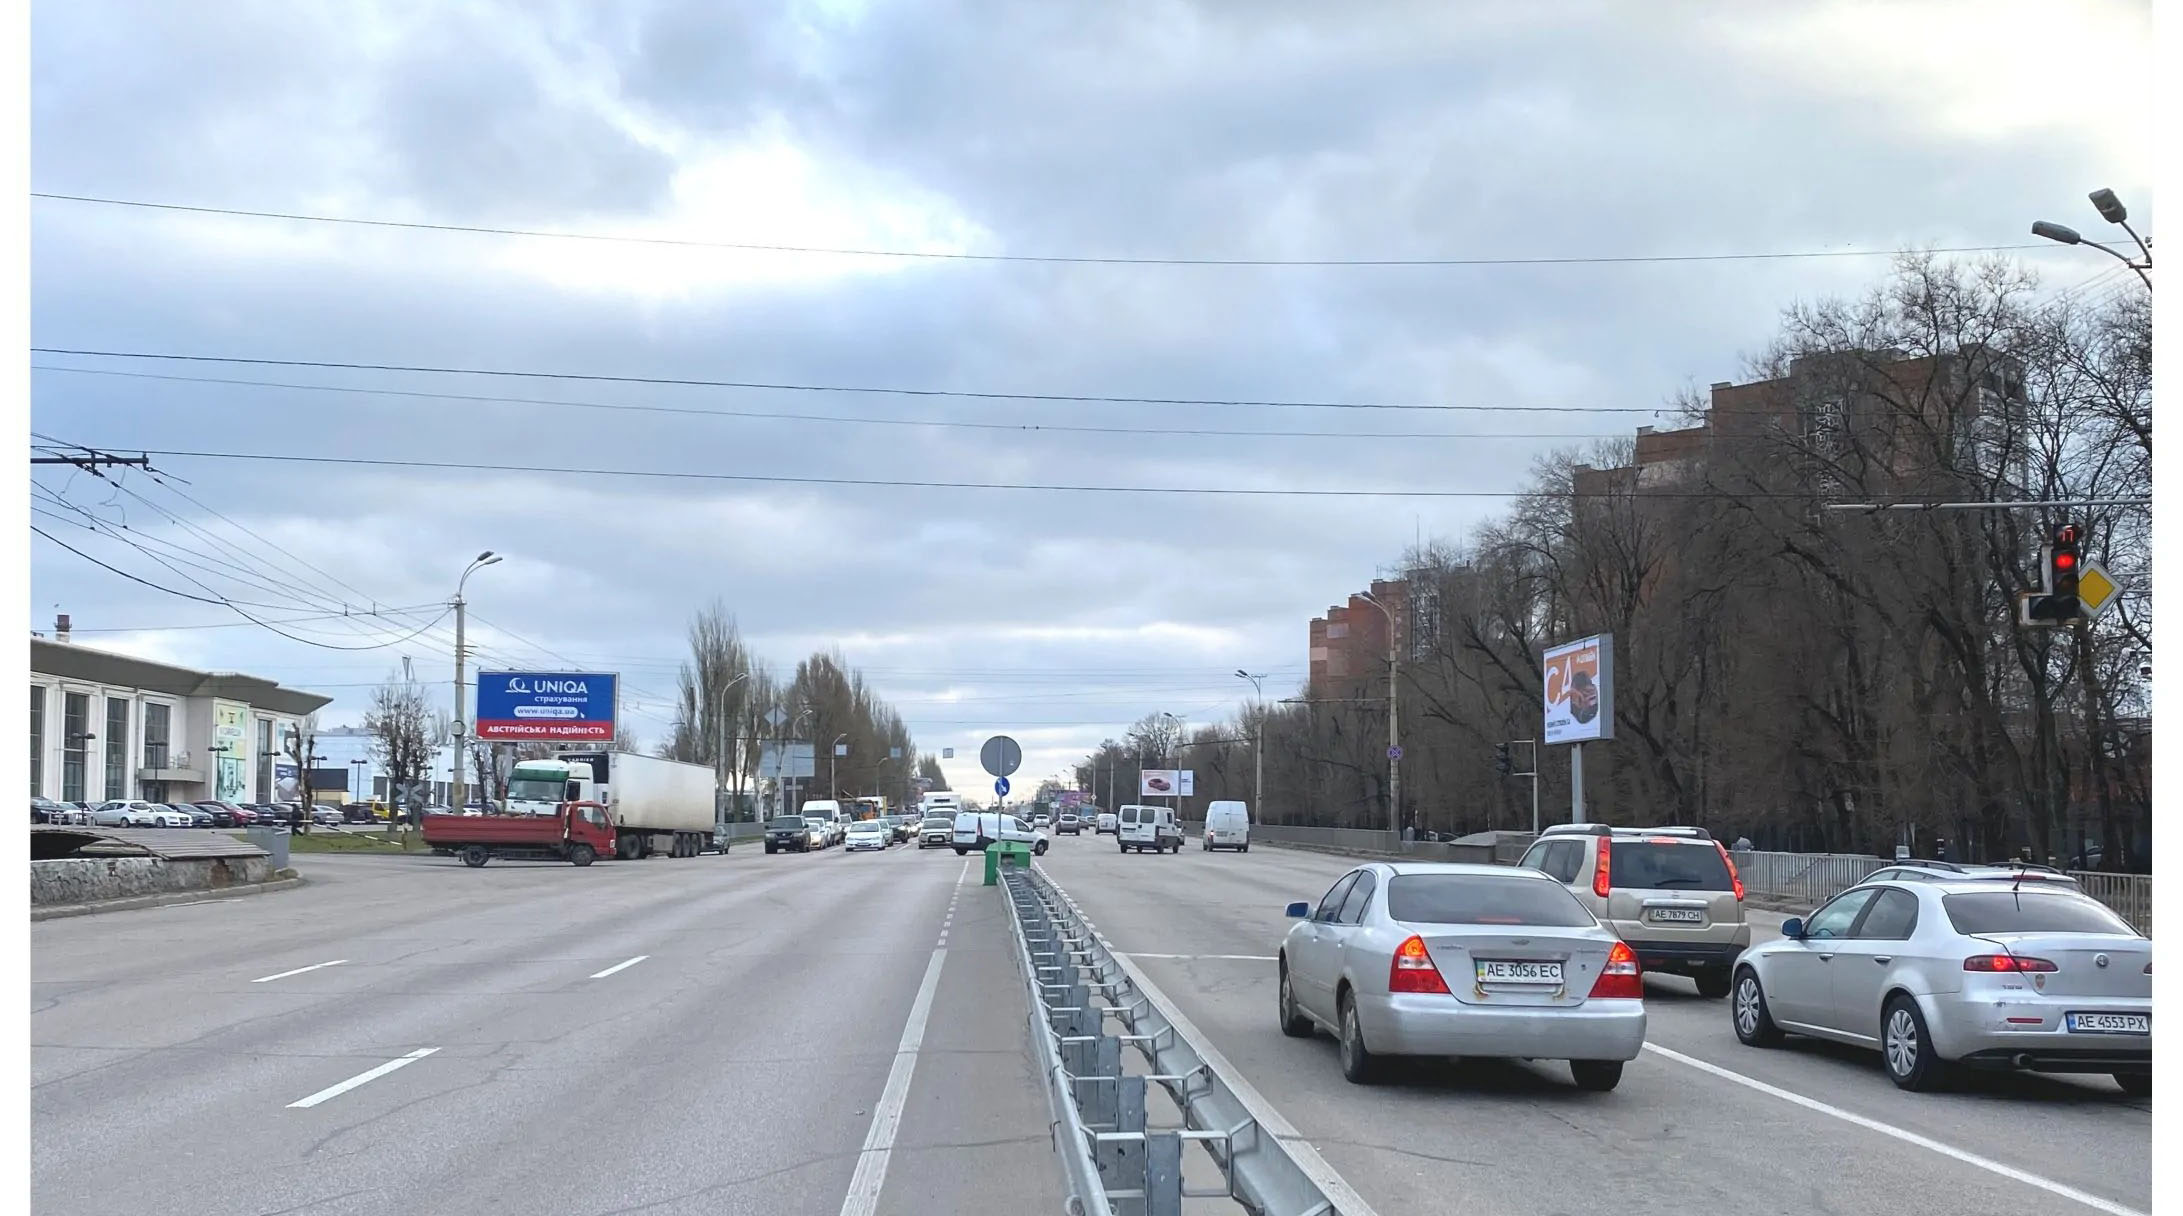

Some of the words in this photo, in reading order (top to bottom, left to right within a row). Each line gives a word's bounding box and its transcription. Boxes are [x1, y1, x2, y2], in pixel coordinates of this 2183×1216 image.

[534, 680, 588, 694] UNIQA
[534, 695, 588, 704] страхування
[517, 708, 575, 717] www.uniqa.ua
[487, 725, 547, 734] АВСТРІЙСЬКА
[549, 726, 605, 735] НАДІЙНІСТЬ
[1655, 910, 1666, 918] AE
[1487, 964, 1504, 977] AE
[1508, 964, 1537, 978] 3056
[1540, 965, 1559, 978] EC
[2077, 1016, 2095, 1028] AE
[2098, 1016, 2125, 1029] 4553
[2128, 1018, 2146, 1029] PX
